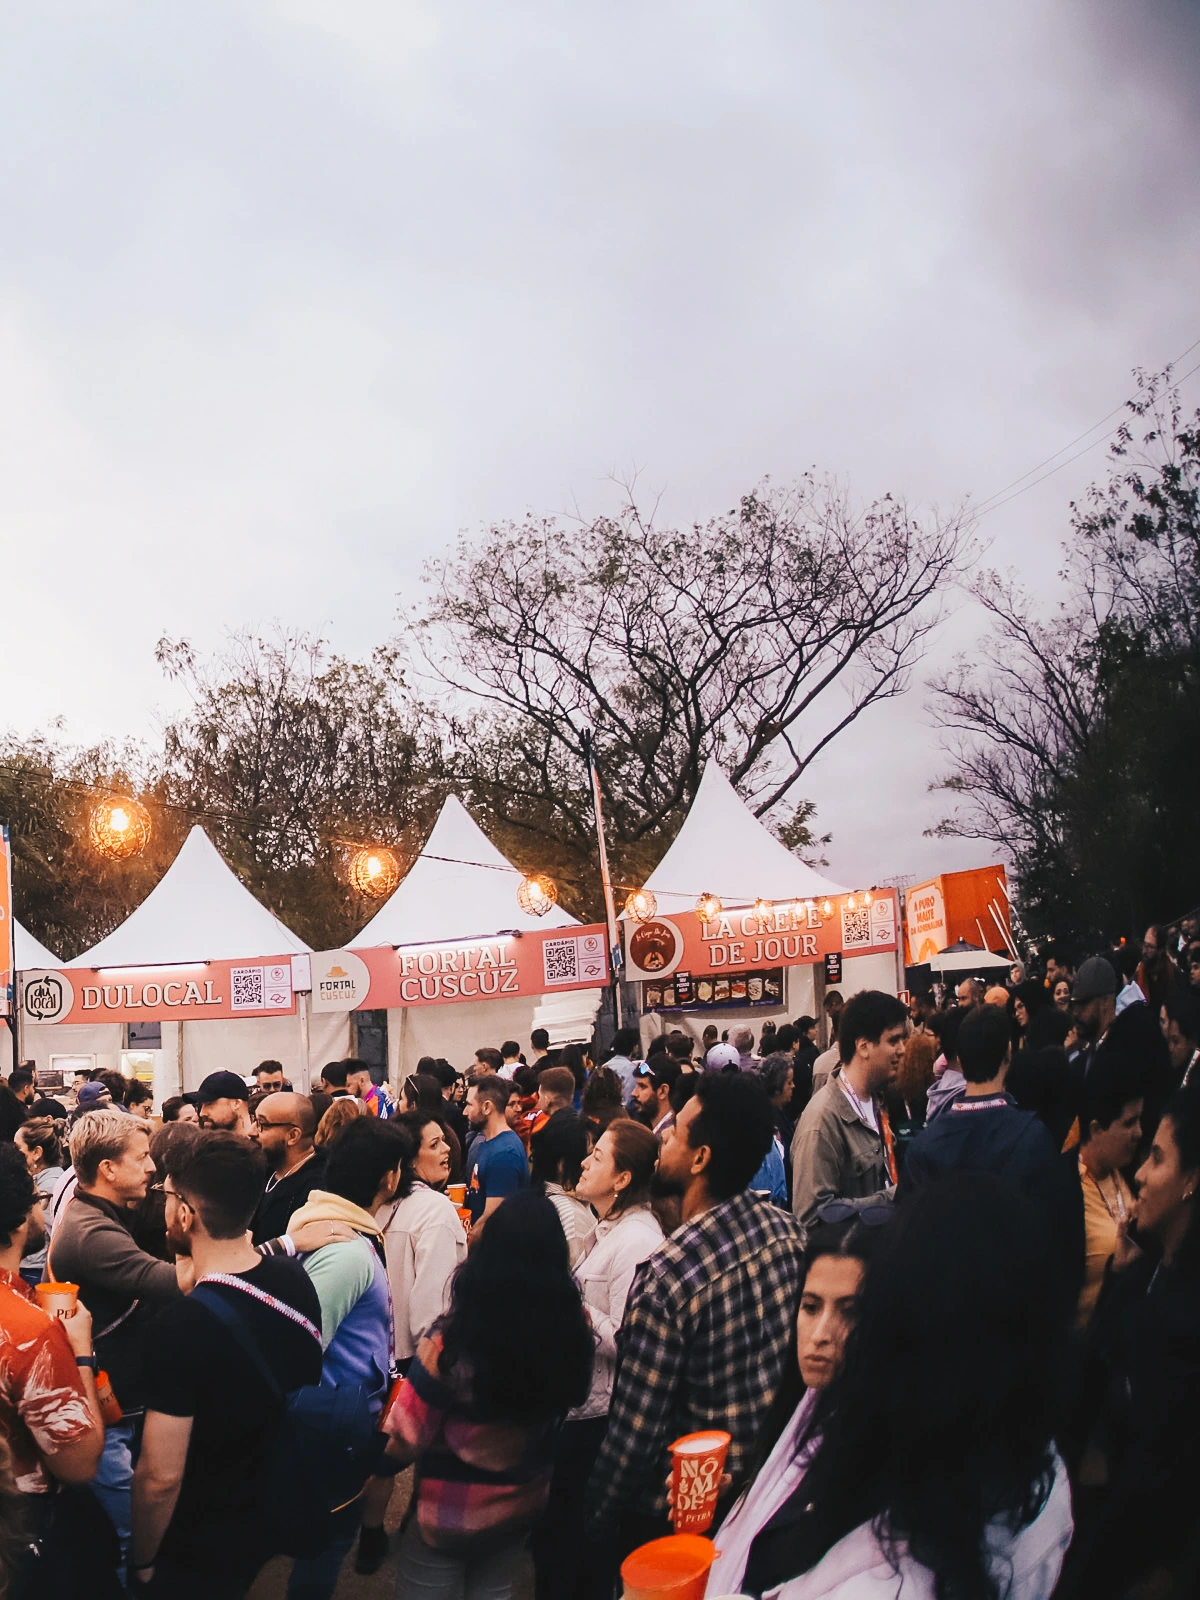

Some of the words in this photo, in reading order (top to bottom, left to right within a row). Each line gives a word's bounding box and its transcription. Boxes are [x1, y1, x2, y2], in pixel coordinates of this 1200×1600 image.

[919, 895, 935, 910] PURO
[701, 917, 736, 941] LA
[399, 944, 516, 977] FORTAL
[709, 942, 745, 967] DE
[751, 934, 819, 962] JOUR
[33, 984, 51, 997] du
[82, 980, 222, 1010] DULOCAL
[319, 980, 356, 991] FORTAL
[320, 989, 357, 1000] CUSCUZ
[400, 968, 519, 1002] CUSCUZ
[30, 992, 57, 1010] local
